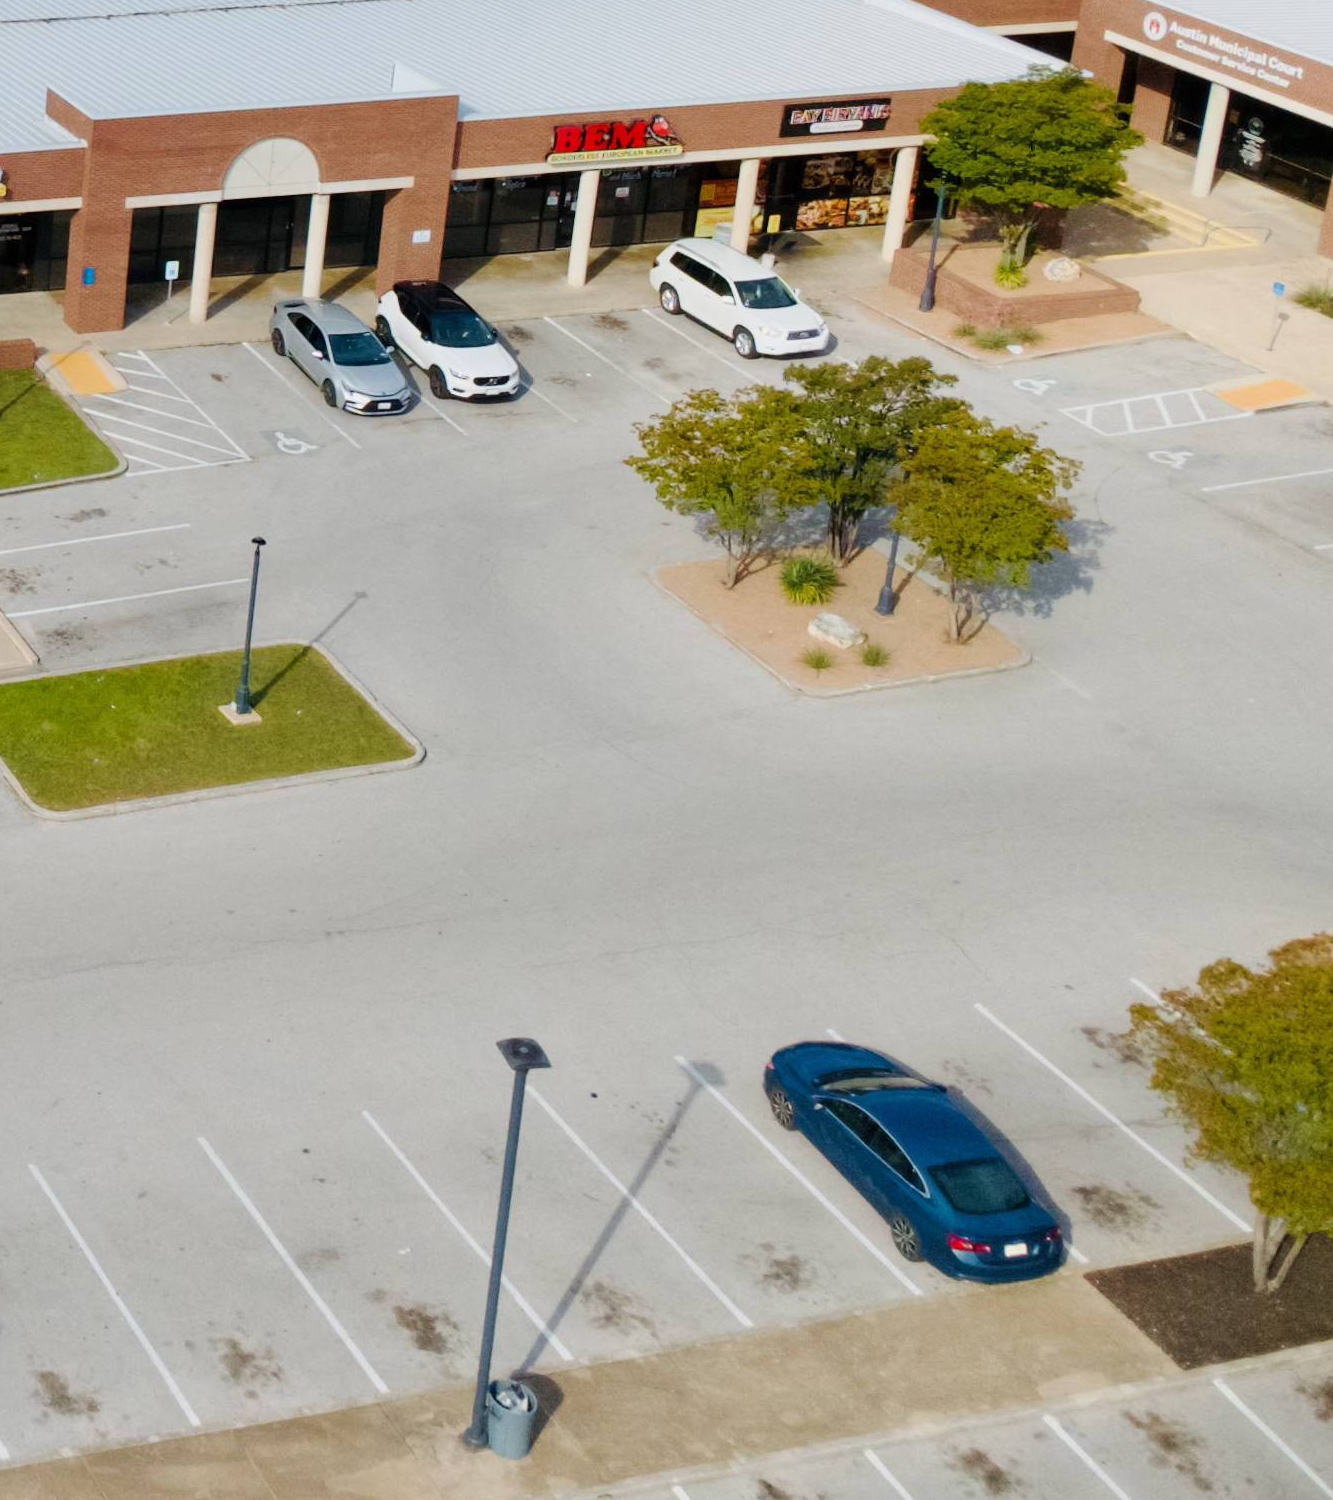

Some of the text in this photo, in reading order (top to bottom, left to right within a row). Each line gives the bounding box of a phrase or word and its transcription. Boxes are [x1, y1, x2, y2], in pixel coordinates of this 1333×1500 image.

[1169, 21, 1303, 80] Austin Municipal Court
[1176, 39, 1290, 88] Customer Service Center
[555, 120, 648, 153] BEM
